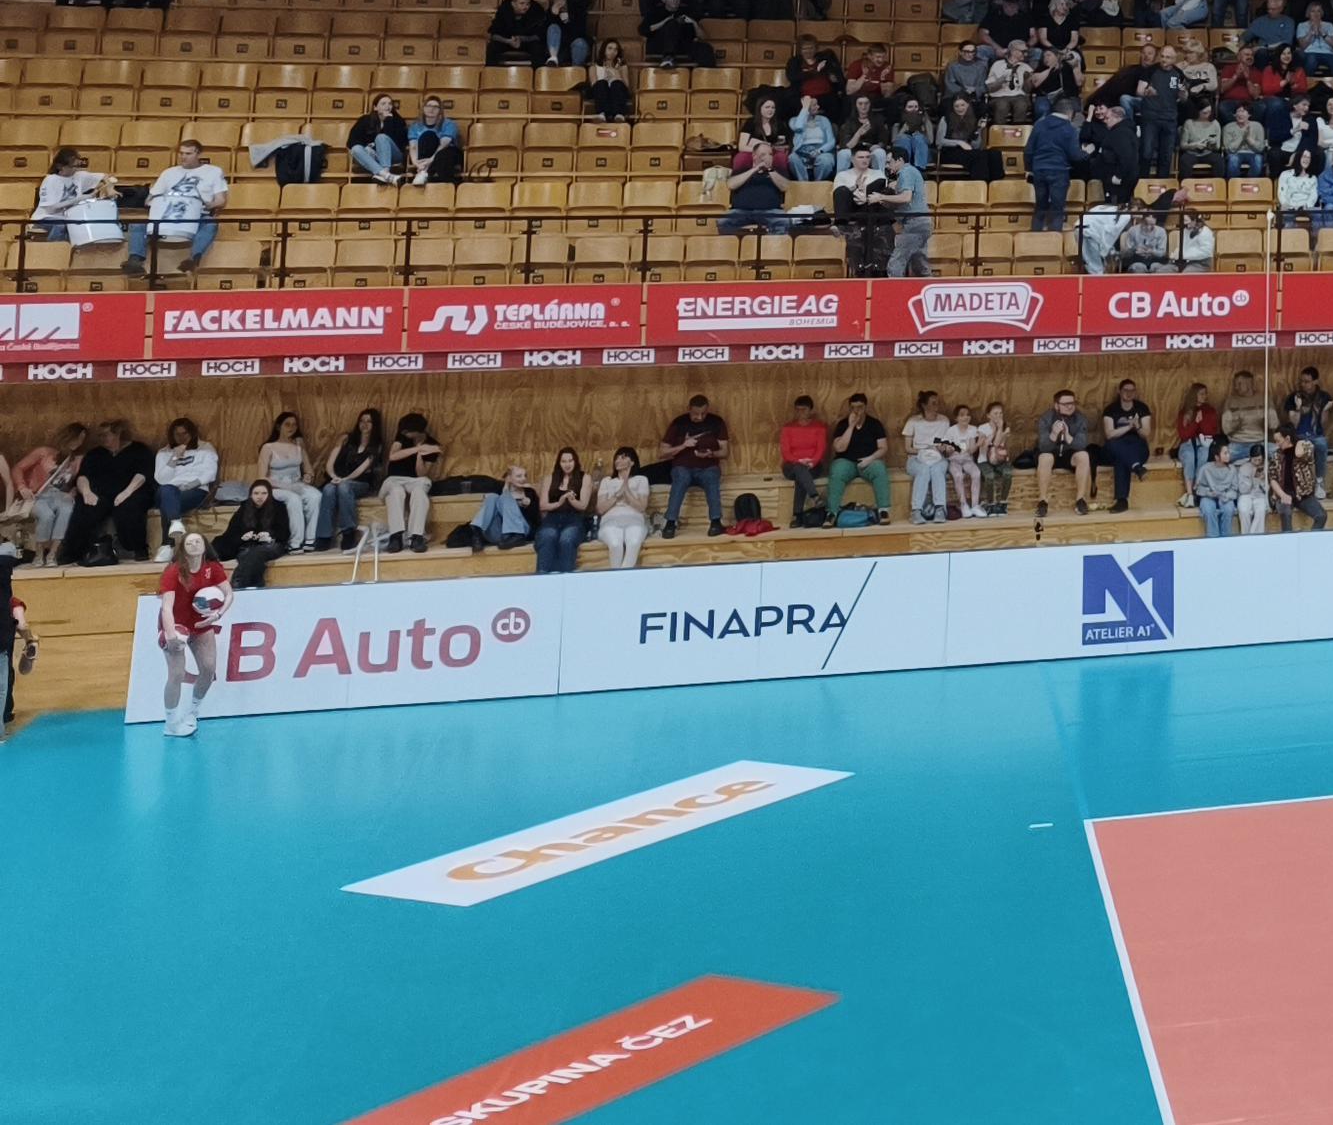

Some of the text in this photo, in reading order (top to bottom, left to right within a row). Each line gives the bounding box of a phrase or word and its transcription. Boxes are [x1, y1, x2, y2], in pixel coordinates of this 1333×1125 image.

[932, 291, 1021, 313] MADETA
[1108, 290, 1231, 319] CB Auto
[164, 306, 384, 332] FACKELMANN
[899, 342, 938, 355] HOCH
[1038, 339, 1075, 351] HOCH
[1166, 335, 1214, 348] HOCH
[608, 349, 650, 362] HOCH
[750, 346, 803, 360] HOCH
[207, 360, 254, 374] HOCH
[373, 355, 418, 369] HOCH
[28, 364, 92, 379] HOCH
[639, 601, 849, 645] FINAPRA
[1085, 626, 1135, 641] ATELIER
[293, 617, 482, 679] Auto
[445, 780, 776, 881] Chance
[430, 1014, 713, 1125] SKUPINA ČEZ
